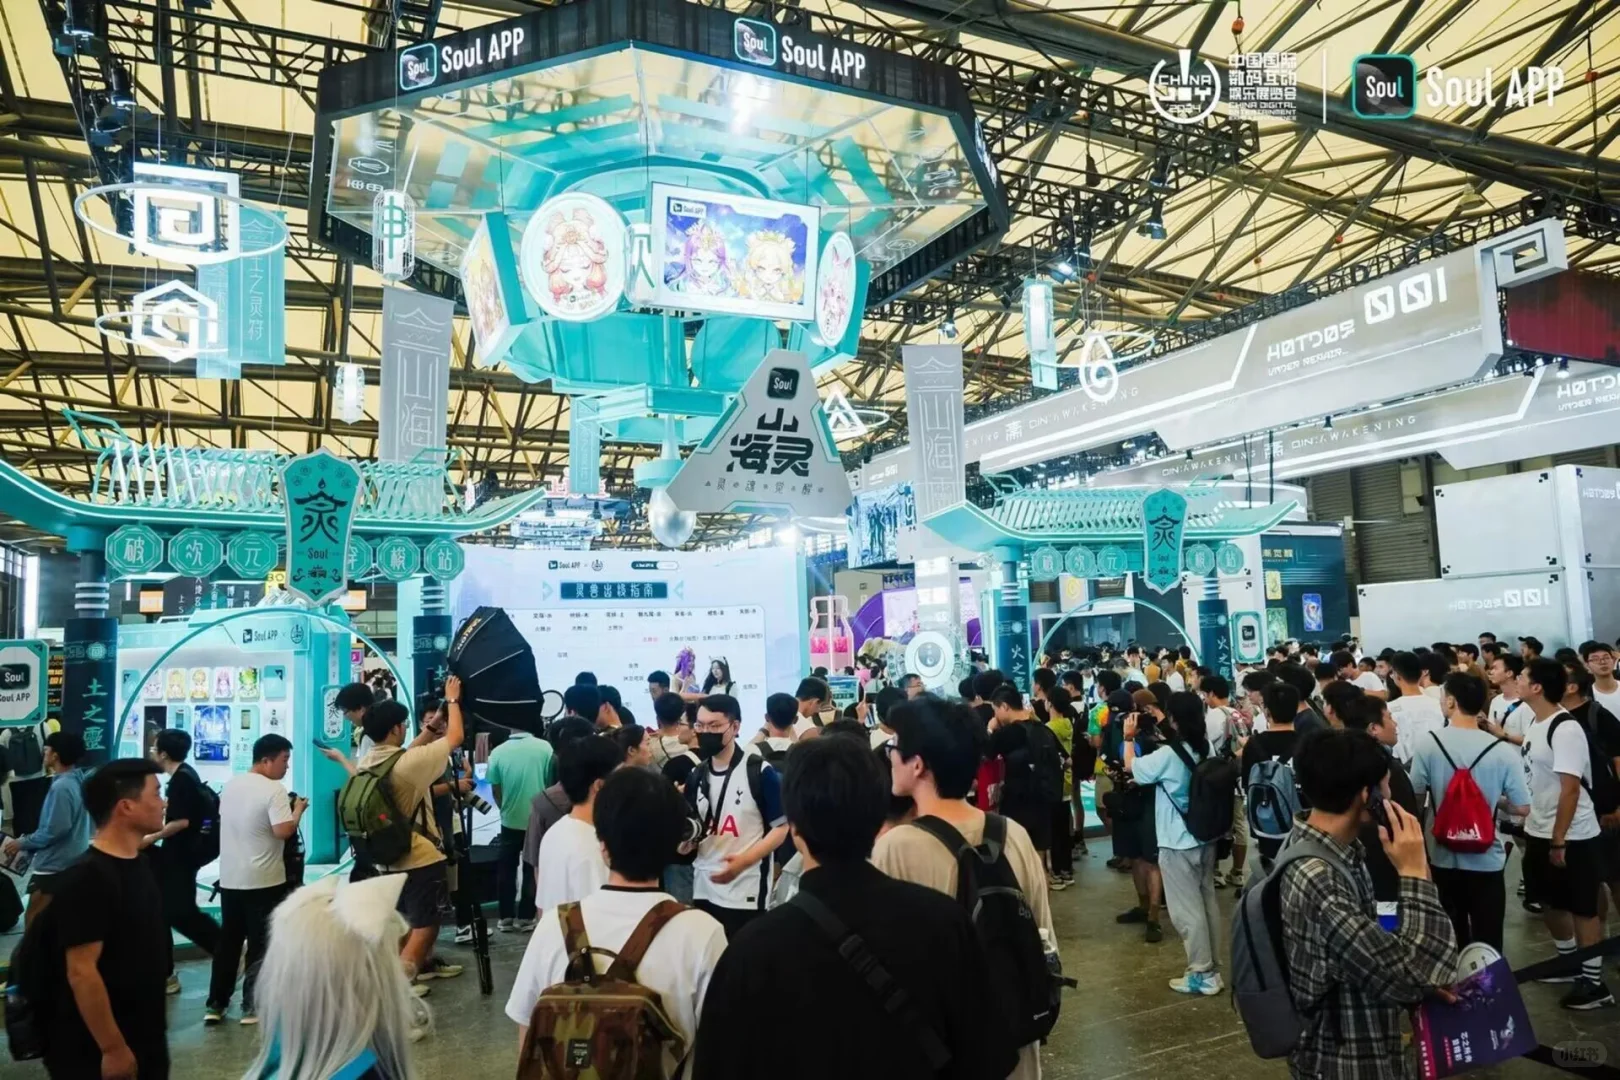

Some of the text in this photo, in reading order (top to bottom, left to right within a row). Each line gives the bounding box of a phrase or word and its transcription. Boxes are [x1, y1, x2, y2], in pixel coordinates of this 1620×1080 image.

[441, 27, 525, 74] Soul APP
[742, 31, 768, 52] Soul
[407, 57, 430, 77] Soul
[781, 35, 866, 79] Soul APP
[773, 377, 793, 392] Soul
[756, 407, 799, 433] 山
[725, 433, 814, 478] 海灵
[123, 536, 262, 568] 破次元
[307, 547, 329, 560] Soul
[559, 561, 581, 569] Soul APP
[254, 630, 278, 643] Soul APP
[4, 671, 25, 683] Soul
[15, 692, 31, 702] APP
